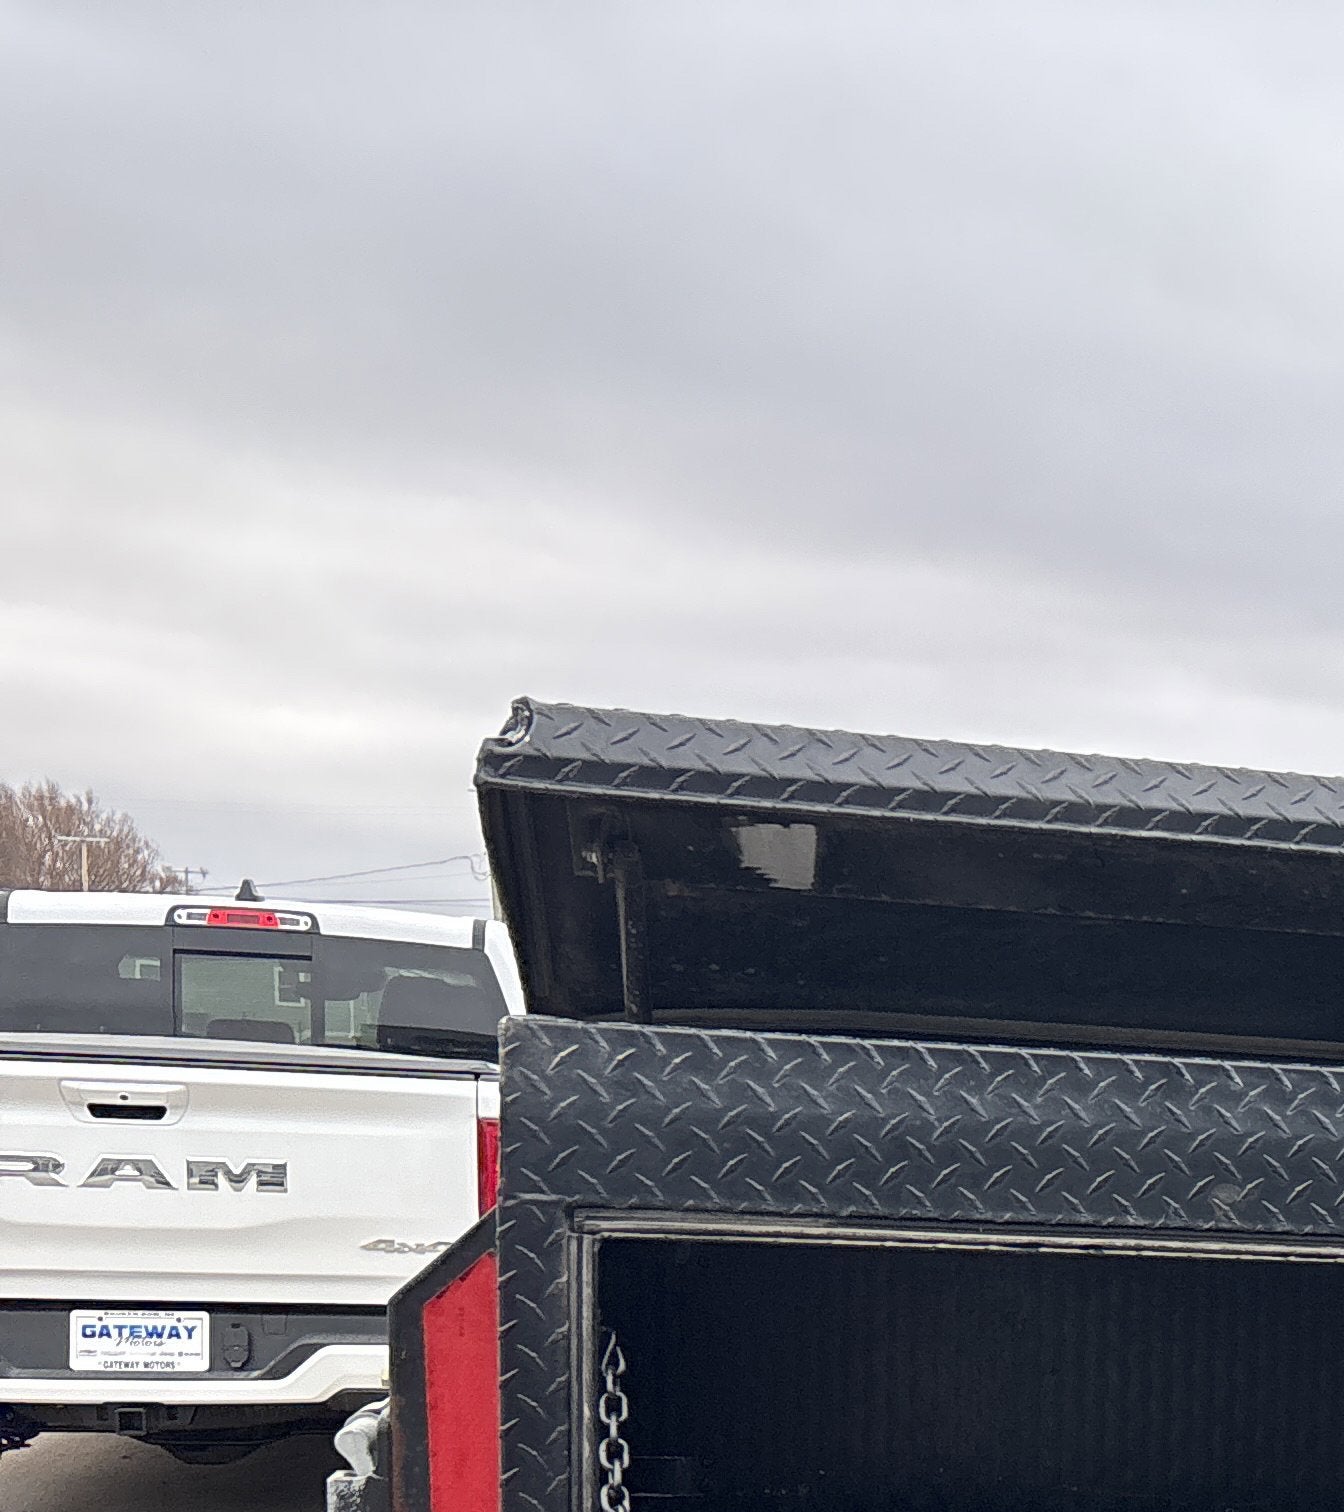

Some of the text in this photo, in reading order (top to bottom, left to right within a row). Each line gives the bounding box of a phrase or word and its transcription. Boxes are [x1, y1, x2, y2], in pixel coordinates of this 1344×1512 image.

[0, 1152, 288, 1194] RAM
[81, 1324, 198, 1340] GATEWAY
[102, 1360, 176, 1370] GATEWAY MOTORS
